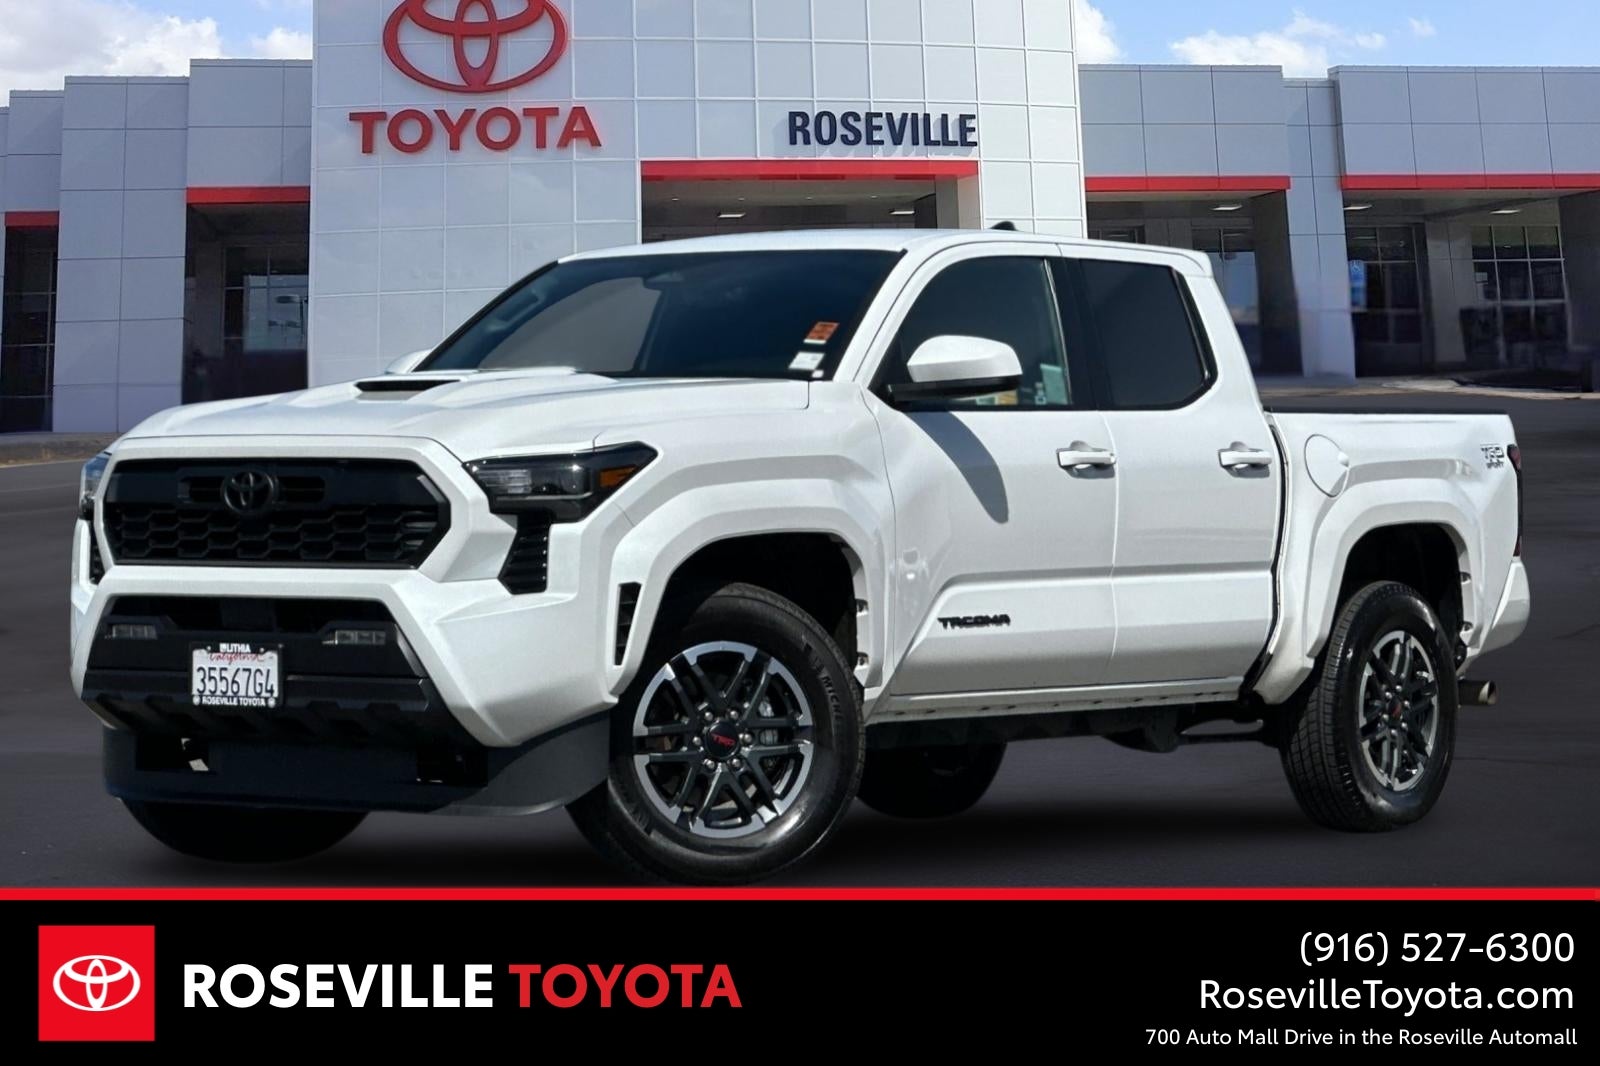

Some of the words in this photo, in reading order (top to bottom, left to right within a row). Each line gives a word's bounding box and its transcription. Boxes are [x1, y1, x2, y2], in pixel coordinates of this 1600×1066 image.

[349, 106, 602, 154] TOYOTA
[788, 111, 978, 148] ROSEVILLE
[937, 613, 1011, 630] TACOMA
[226, 643, 251, 654] LITHIA
[196, 666, 275, 696] 35567G4
[202, 696, 239, 706] ROSEVILLE
[240, 697, 266, 707] TOYOTA
